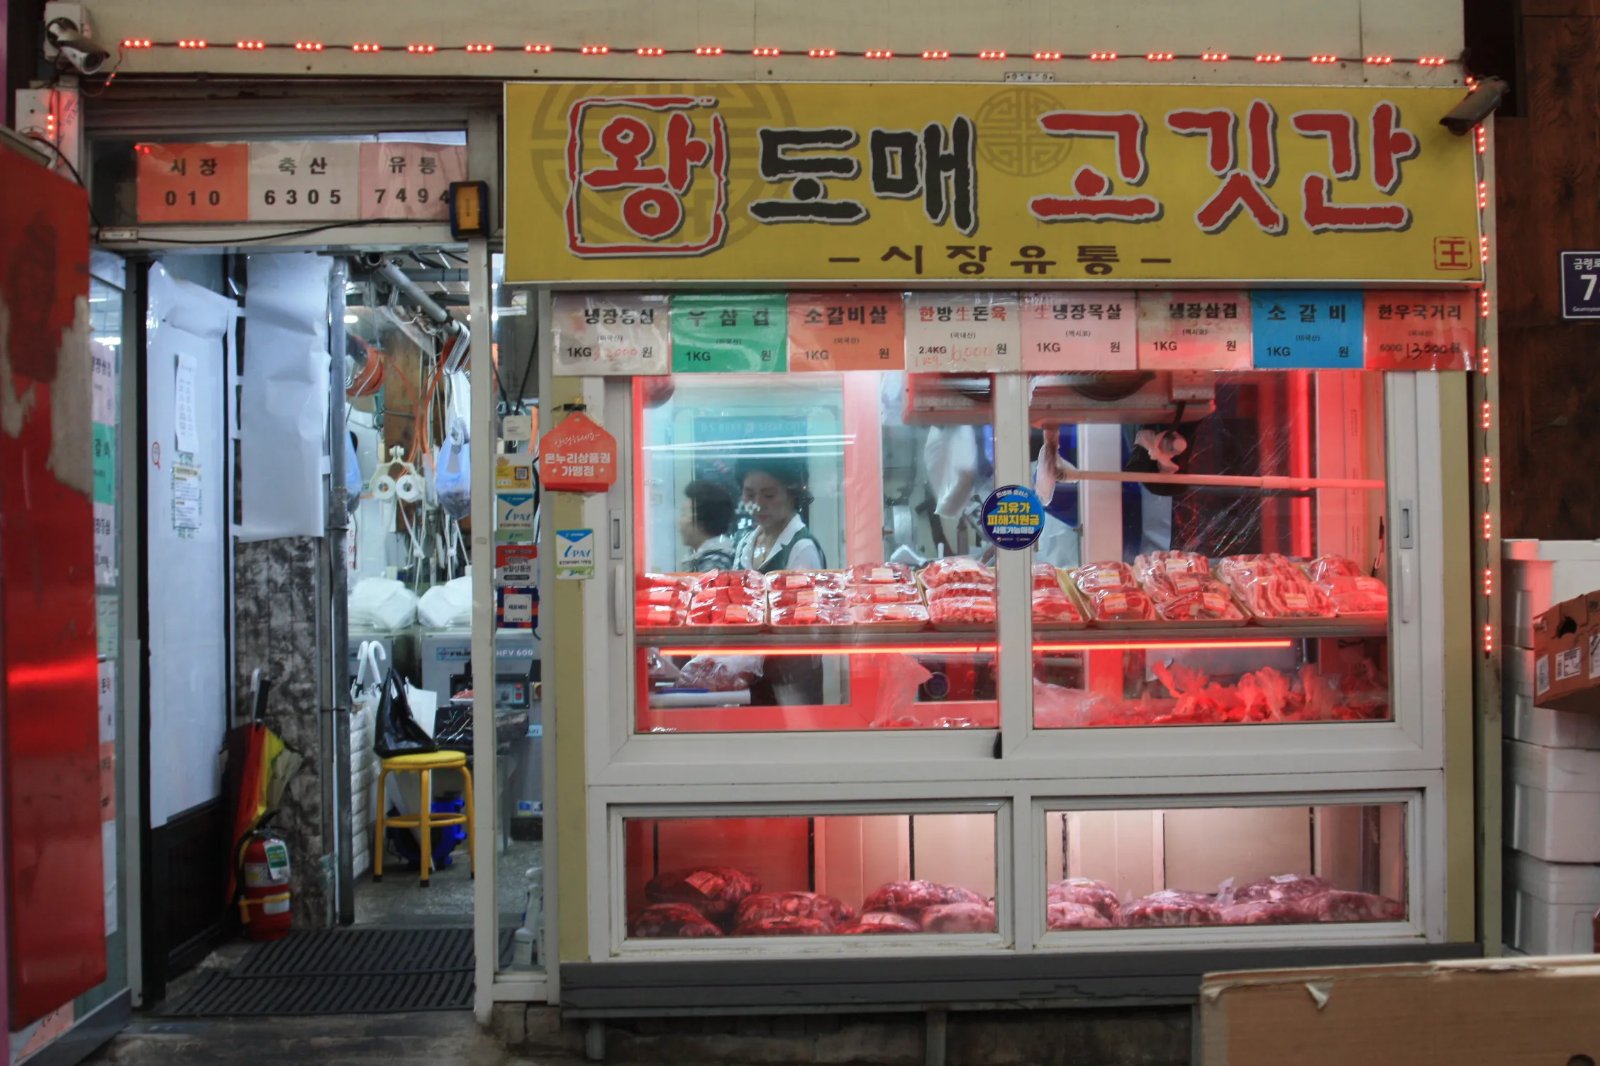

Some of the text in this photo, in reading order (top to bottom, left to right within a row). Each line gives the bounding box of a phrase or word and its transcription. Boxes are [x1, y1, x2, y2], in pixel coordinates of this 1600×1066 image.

[170, 155, 437, 175] 시장 축산 유통
[582, 98, 1420, 239] 왕 도매 고깃간
[165, 187, 450, 206] 010 6305 7494
[1580, 273, 1600, 302] 7
[804, 305, 888, 326] 소갈비살
[918, 305, 1008, 323] 한방生돈육
[1169, 302, 1237, 319] 냉장삼겹
[1267, 304, 1346, 323] 소갈비
[567, 347, 592, 358] 1KG
[641, 346, 653, 358] 원
[918, 345, 947, 354] 2.4KG
[996, 343, 1007, 355] 원
[1036, 341, 1121, 353] 1KG 원
[1153, 340, 1237, 352] 1KG 원
[1267, 346, 1349, 358] 1KG 원
[686, 351, 711, 362] 1KG
[805, 347, 890, 360] 1KG 원
[545, 452, 611, 464] 온누리상품권
[561, 465, 595, 477] 가맹점
[997, 501, 1031, 513] 고유가
[987, 514, 1040, 526] 피해지원금
